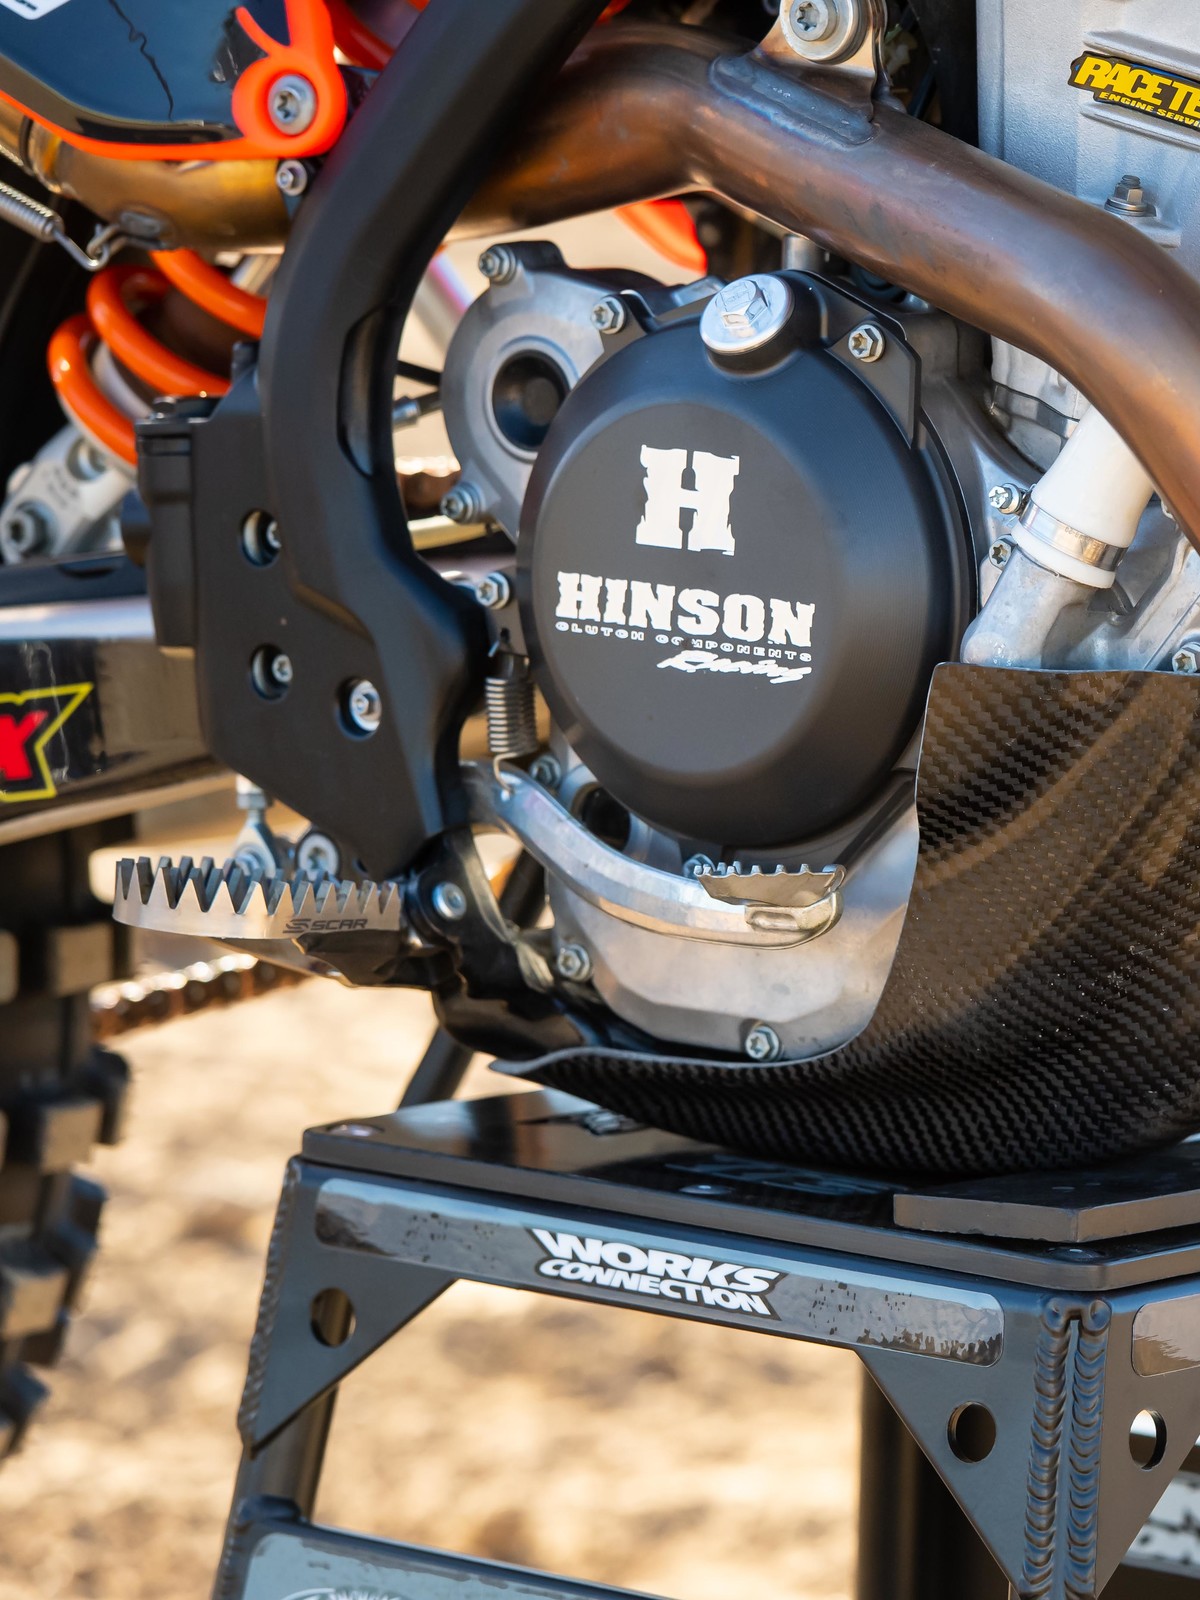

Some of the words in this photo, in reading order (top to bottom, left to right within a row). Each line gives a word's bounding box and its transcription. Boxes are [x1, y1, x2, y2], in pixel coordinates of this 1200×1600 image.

[1074, 56, 1173, 106] RACE
[1099, 91, 1154, 113] ENGINE
[635, 444, 741, 557] H
[555, 571, 816, 648] HINSON
[311, 918, 368, 931] SCAR
[531, 1228, 781, 1293] WORKS
[538, 1258, 772, 1316] CONNECTION
